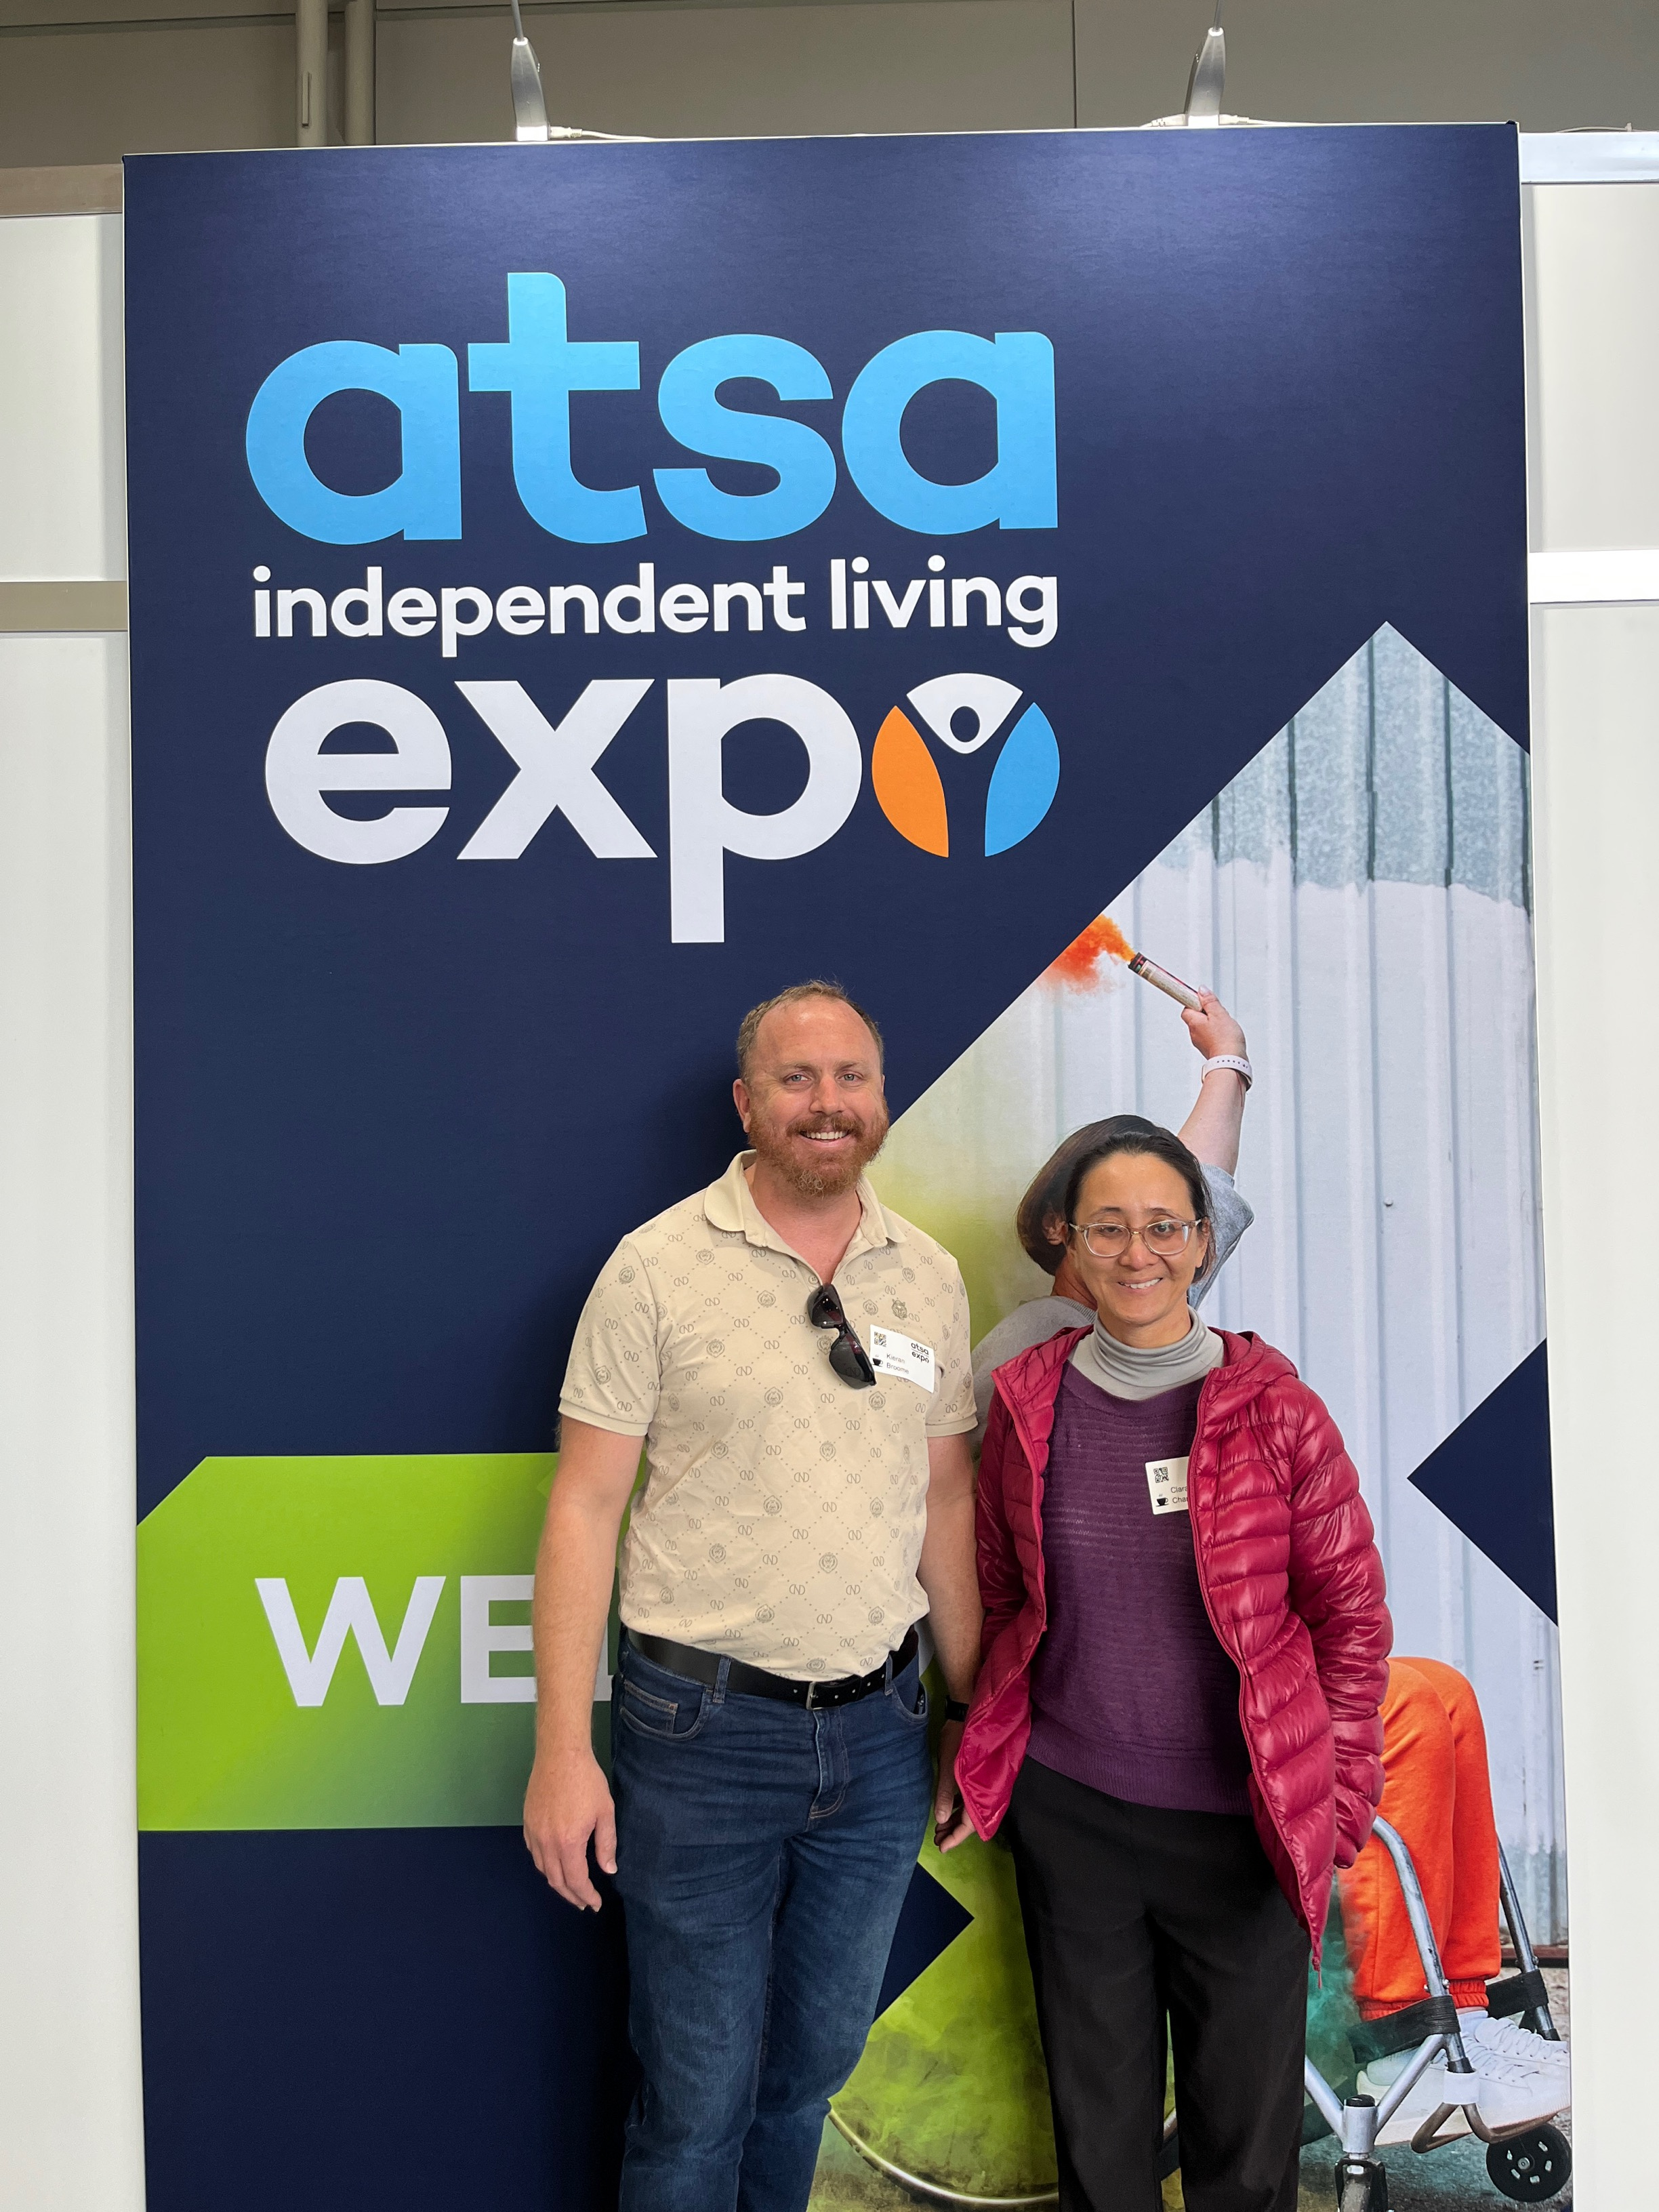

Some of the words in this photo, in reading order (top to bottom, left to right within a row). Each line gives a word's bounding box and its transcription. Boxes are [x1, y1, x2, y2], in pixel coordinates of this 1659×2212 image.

[246, 272, 1058, 545] atsa
[253, 562, 806, 658] independent
[831, 554, 1058, 648] living
[911, 1343, 929, 1355] atsa
[886, 1353, 905, 1364] Kieran
[886, 1362, 909, 1374] Broome
